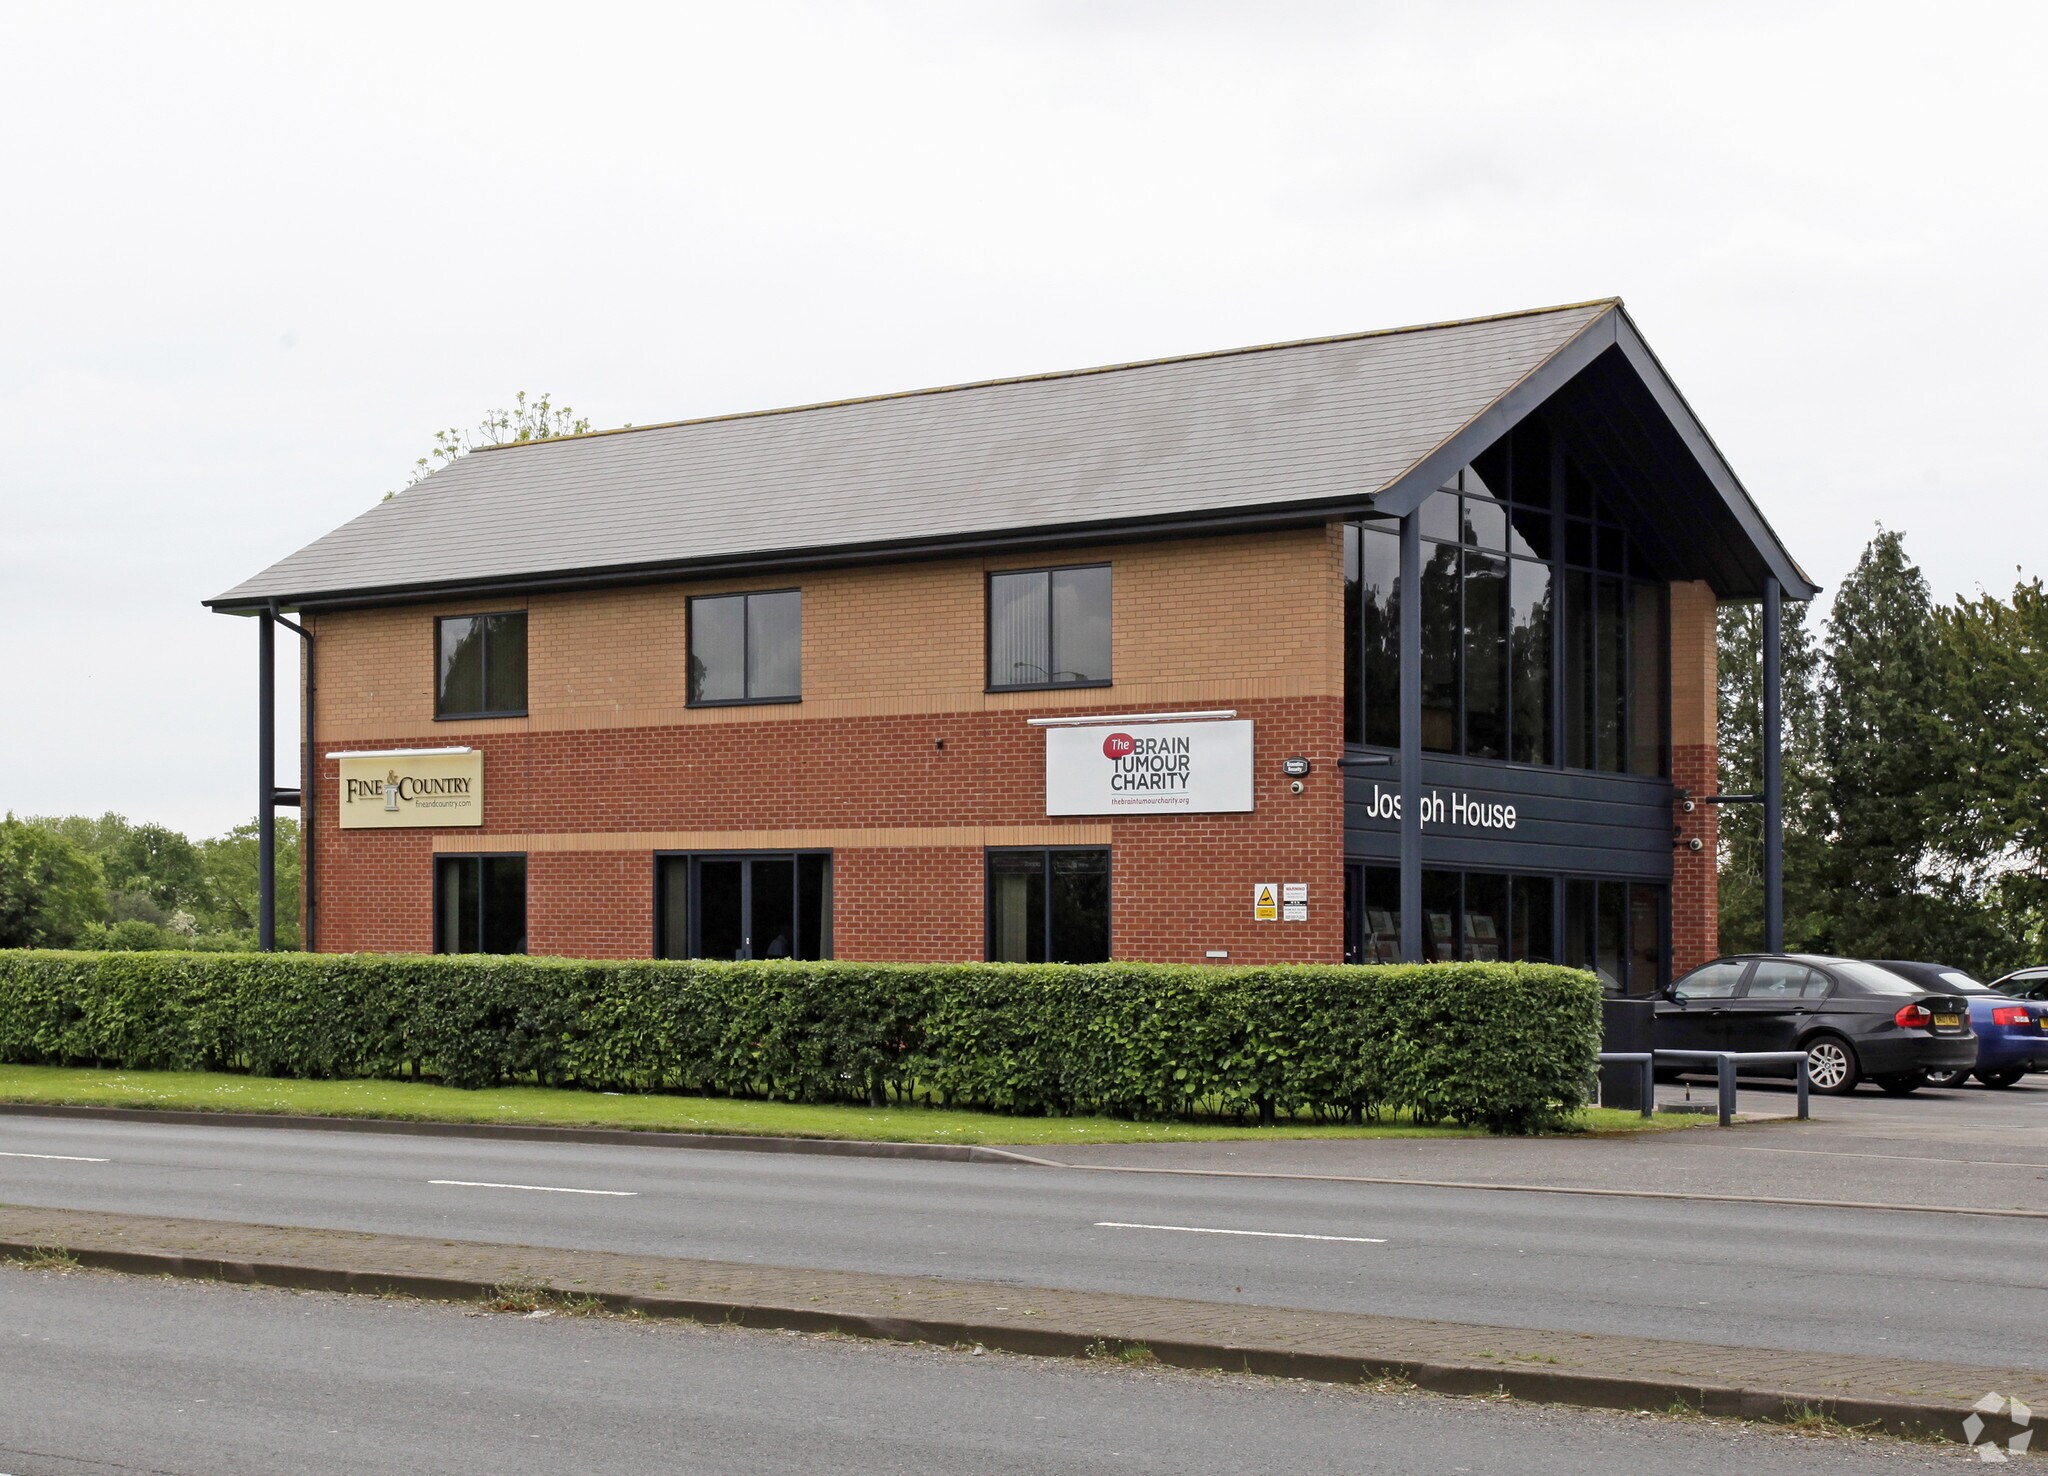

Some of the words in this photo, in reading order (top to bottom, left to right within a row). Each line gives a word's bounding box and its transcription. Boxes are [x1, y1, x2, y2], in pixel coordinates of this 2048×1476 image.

[1111, 738, 1130, 750] The
[1133, 736, 1190, 755] BRAIN
[1111, 754, 1190, 773] TUMOUR
[346, 778, 383, 804] FINE
[387, 769, 399, 785] &
[399, 776, 472, 801] COUNTRY
[1111, 772, 1190, 791] CHARITY
[415, 799, 472, 809] fineandcountry.com
[1111, 796, 1190, 806] thebraintumourcharity.org
[1366, 784, 1445, 829] Josph
[1452, 792, 1517, 829] House
